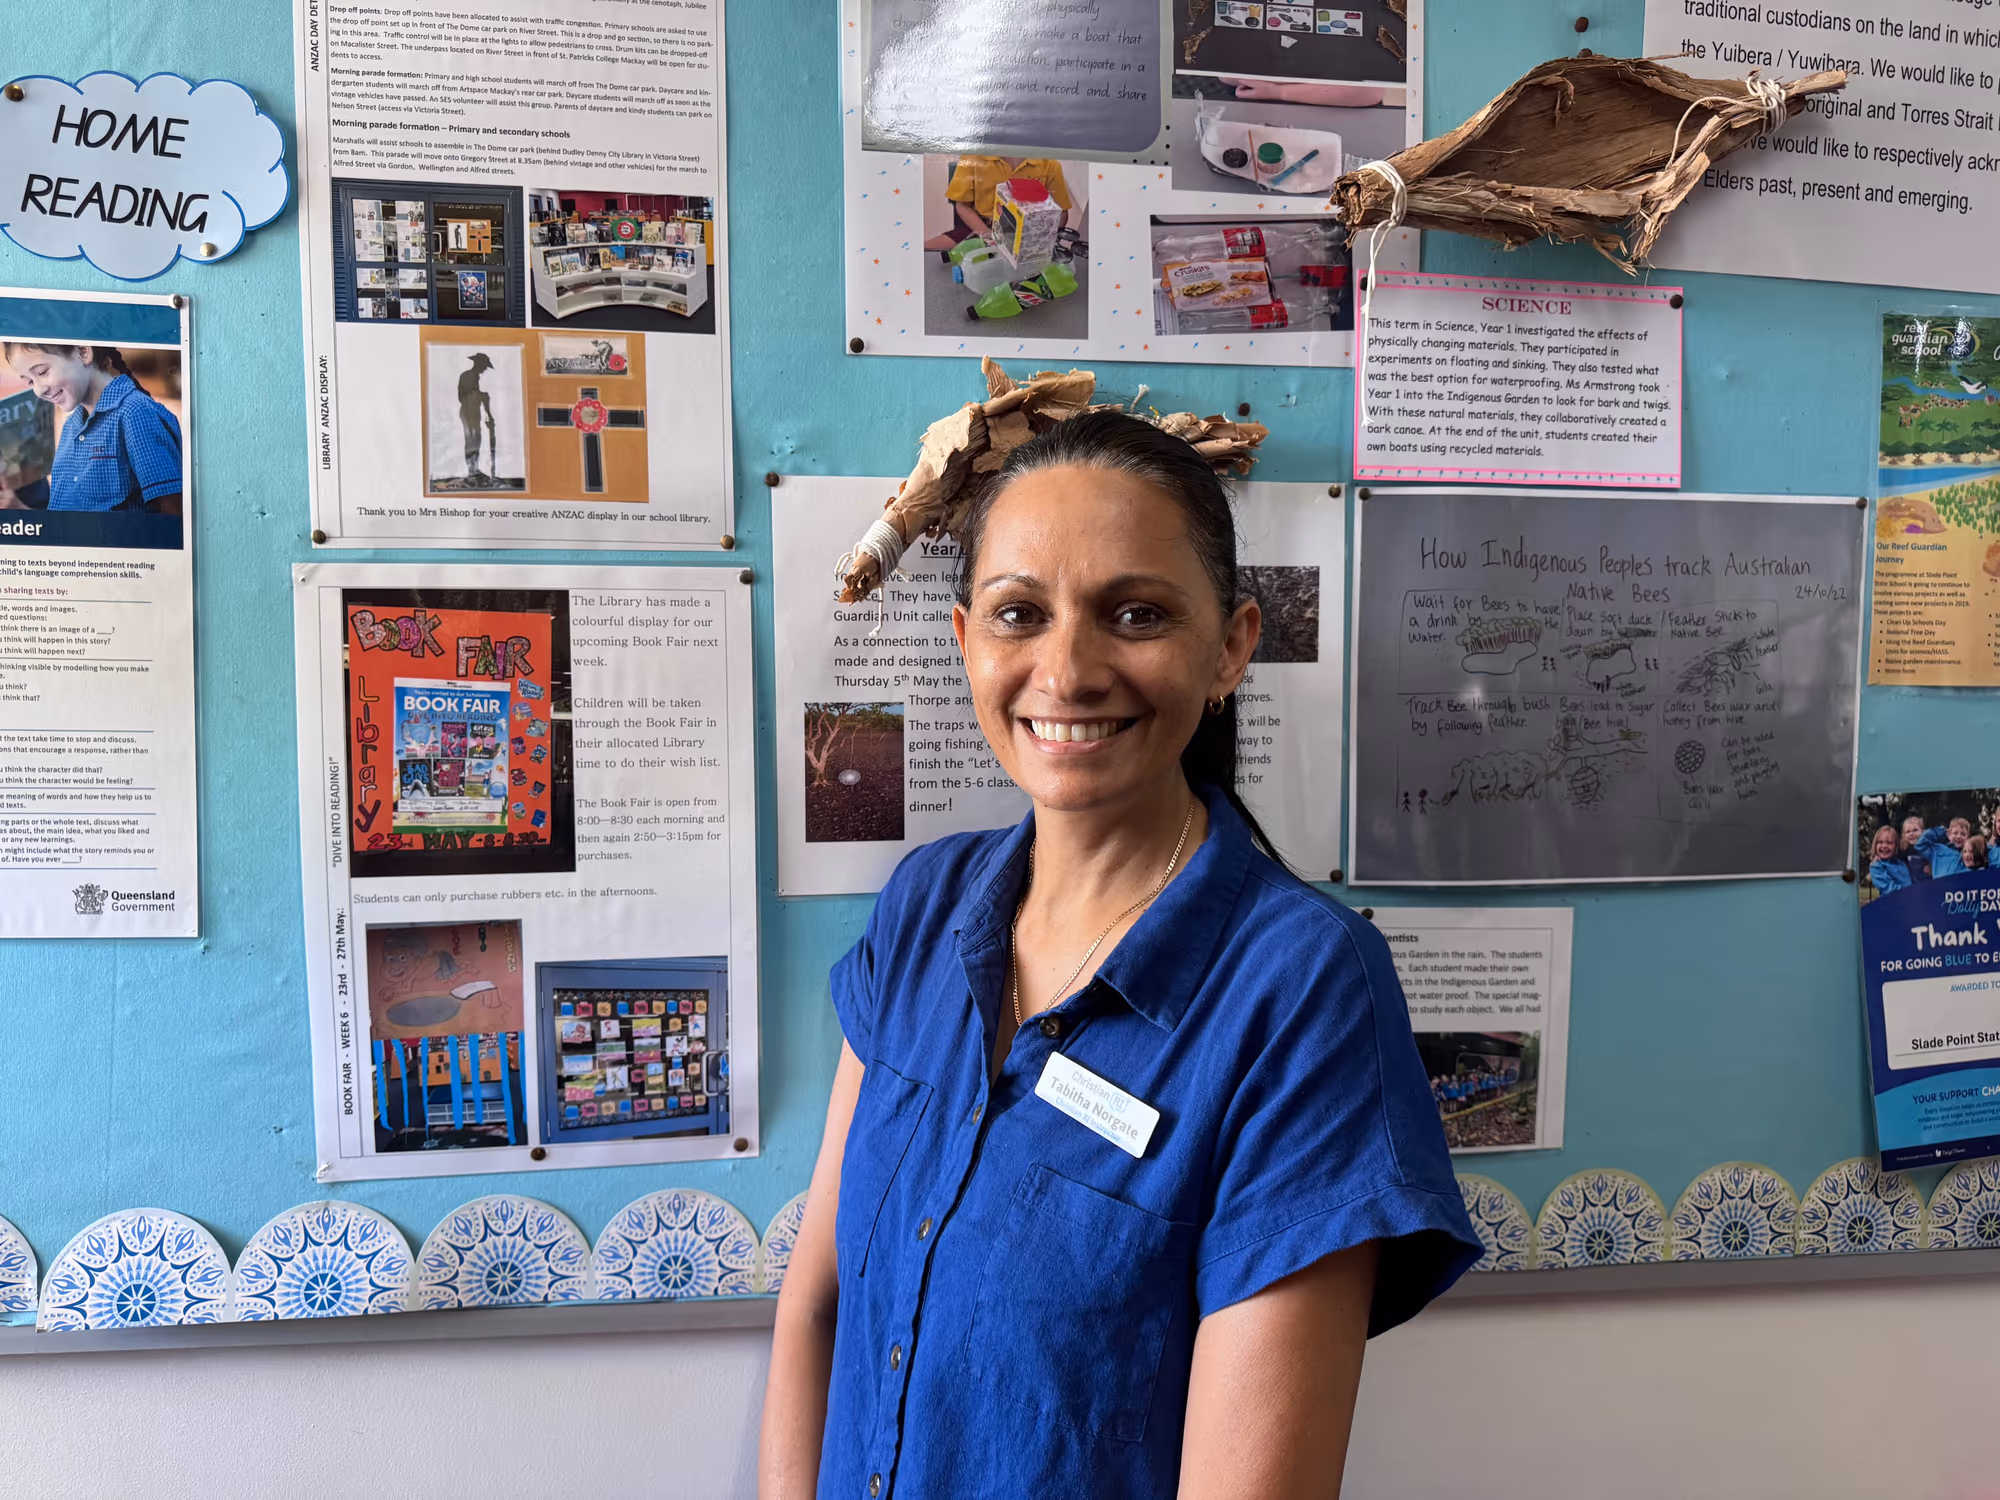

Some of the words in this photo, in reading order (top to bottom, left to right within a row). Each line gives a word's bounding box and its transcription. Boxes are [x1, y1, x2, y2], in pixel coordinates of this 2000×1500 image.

[310, 19, 318, 37] DAY
[1684, 0, 1761, 23] traditional
[1766, 9, 1851, 32] custodians
[1855, 18, 1874, 35] on
[1879, 20, 1904, 38] the
[1908, 23, 1941, 42] land
[1945, 28, 1958, 44] in
[1085, 29, 1110, 43] boat
[1117, 32, 1143, 45] that
[311, 39, 319, 72] ANZAC
[1679, 38, 1706, 59] the
[1711, 41, 1772, 66] Yuibera
[1776, 49, 1783, 67] /
[1870, 58, 1896, 79] We
[1900, 64, 1945, 84] would
[1949, 66, 1975, 87] like
[1979, 70, 1994, 89] to
[1015, 80, 1038, 92] and
[1045, 81, 1080, 96] record
[1086, 84, 1111, 98] and
[1117, 87, 1148, 101] share
[52, 105, 189, 159] HOME
[332, 118, 369, 129] Morning
[368, 121, 398, 130] parade
[399, 121, 440, 131] formation
[448, 124, 480, 135] Primary
[481, 126, 497, 134] and
[498, 128, 540, 138] secondary
[540, 129, 571, 138] schools
[1702, 167, 1754, 191] Elders
[1758, 176, 1796, 198] past,
[1801, 181, 1861, 201] present
[1864, 186, 1894, 203] and
[1898, 190, 1972, 215] emerging.
[21, 173, 209, 233] READING
[1174, 265, 1210, 278] Cruskits
[1482, 296, 1571, 315] SCIENCE
[1368, 317, 1391, 329] This
[1393, 319, 1420, 330] term
[1422, 319, 1432, 330] in
[1434, 320, 1478, 334] Science,
[1479, 322, 1504, 333] Year
[1514, 323, 1575, 339] investigated
[1577, 327, 1595, 338] the
[1596, 328, 1635, 341] effects
[1636, 330, 1648, 341] of
[319, 354, 329, 394] DISPLAY:
[320, 395, 329, 428] ANZAC
[322, 432, 331, 470] LIBRARY
[1366, 443, 1386, 452] own
[1388, 440, 1418, 452] boats
[1420, 442, 1447, 456] using
[1449, 444, 1493, 456] recycled
[1495, 446, 1544, 456] materials.
[356, 506, 386, 516] Thank
[388, 508, 405, 517] you
[407, 508, 417, 516] to
[419, 507, 437, 517] Mrs
[439, 507, 471, 518] Bishop
[472, 508, 487, 517] for
[488, 510, 510, 518] your
[511, 509, 549, 519] creative
[550, 509, 585, 519] ANZAC
[587, 510, 618, 521] display
[620, 511, 629, 521] in
[649, 512, 677, 522] school
[679, 513, 711, 524] library.
[921, 542, 956, 555] Year
[1876, 542, 1890, 550] Our
[1911, 543, 1947, 551] Guardian
[1421, 537, 1466, 570] How
[1481, 535, 1587, 582] Indigenous
[1664, 554, 1712, 577] track
[1724, 552, 1811, 577] Australian
[1876, 556, 1905, 565] Journey
[3, 586, 33, 596] sharing
[34, 587, 55, 595] texts
[56, 587, 68, 596] by:
[1566, 581, 1615, 601] Native
[1632, 583, 1671, 603] Bees
[572, 595, 595, 607] The
[599, 596, 642, 608] Library
[646, 597, 667, 607] has
[670, 598, 700, 608] made
[704, 600, 711, 608] a
[833, 610, 889, 622] Guardian
[893, 611, 918, 622] Unit
[351, 609, 446, 658] BOOK
[456, 635, 534, 680] FAIR
[834, 676, 889, 688] Thursday
[914, 676, 940, 688] May
[943, 675, 962, 686] the
[404, 696, 459, 713] BOOK
[462, 698, 501, 714] FAIR
[909, 799, 952, 812] dinner!
[331, 813, 341, 837] INTO
[423, 831, 476, 850] MAY
[111, 890, 175, 902] Queensland
[1945, 891, 1964, 903] DO
[1966, 890, 1978, 901] IT
[111, 902, 175, 912] Government
[1911, 921, 1988, 951] Thank
[1408, 950, 1440, 959] Garden
[1441, 950, 1449, 959] in
[1451, 950, 1465, 959] the
[1467, 950, 1486, 959] rain.
[1491, 950, 1506, 959] The
[1508, 950, 1543, 959] students
[1881, 961, 1903, 973] FOR
[1905, 956, 1942, 970] GOING
[1945, 954, 1972, 966] BLUE
[1975, 953, 1990, 964] TO
[1950, 981, 1989, 993] AWARDED
[1911, 1037, 1943, 1051] Slade
[1946, 1034, 1975, 1046] Point
[1977, 1031, 2000, 1043] Stat
[1072, 1071, 1111, 1101] Christian
[1912, 1095, 1937, 1104] YOUR
[1939, 1088, 1980, 1102] SUPPORT
[1050, 1076, 1090, 1110] Tabitha
[1092, 1102, 1139, 1141] Norgate
